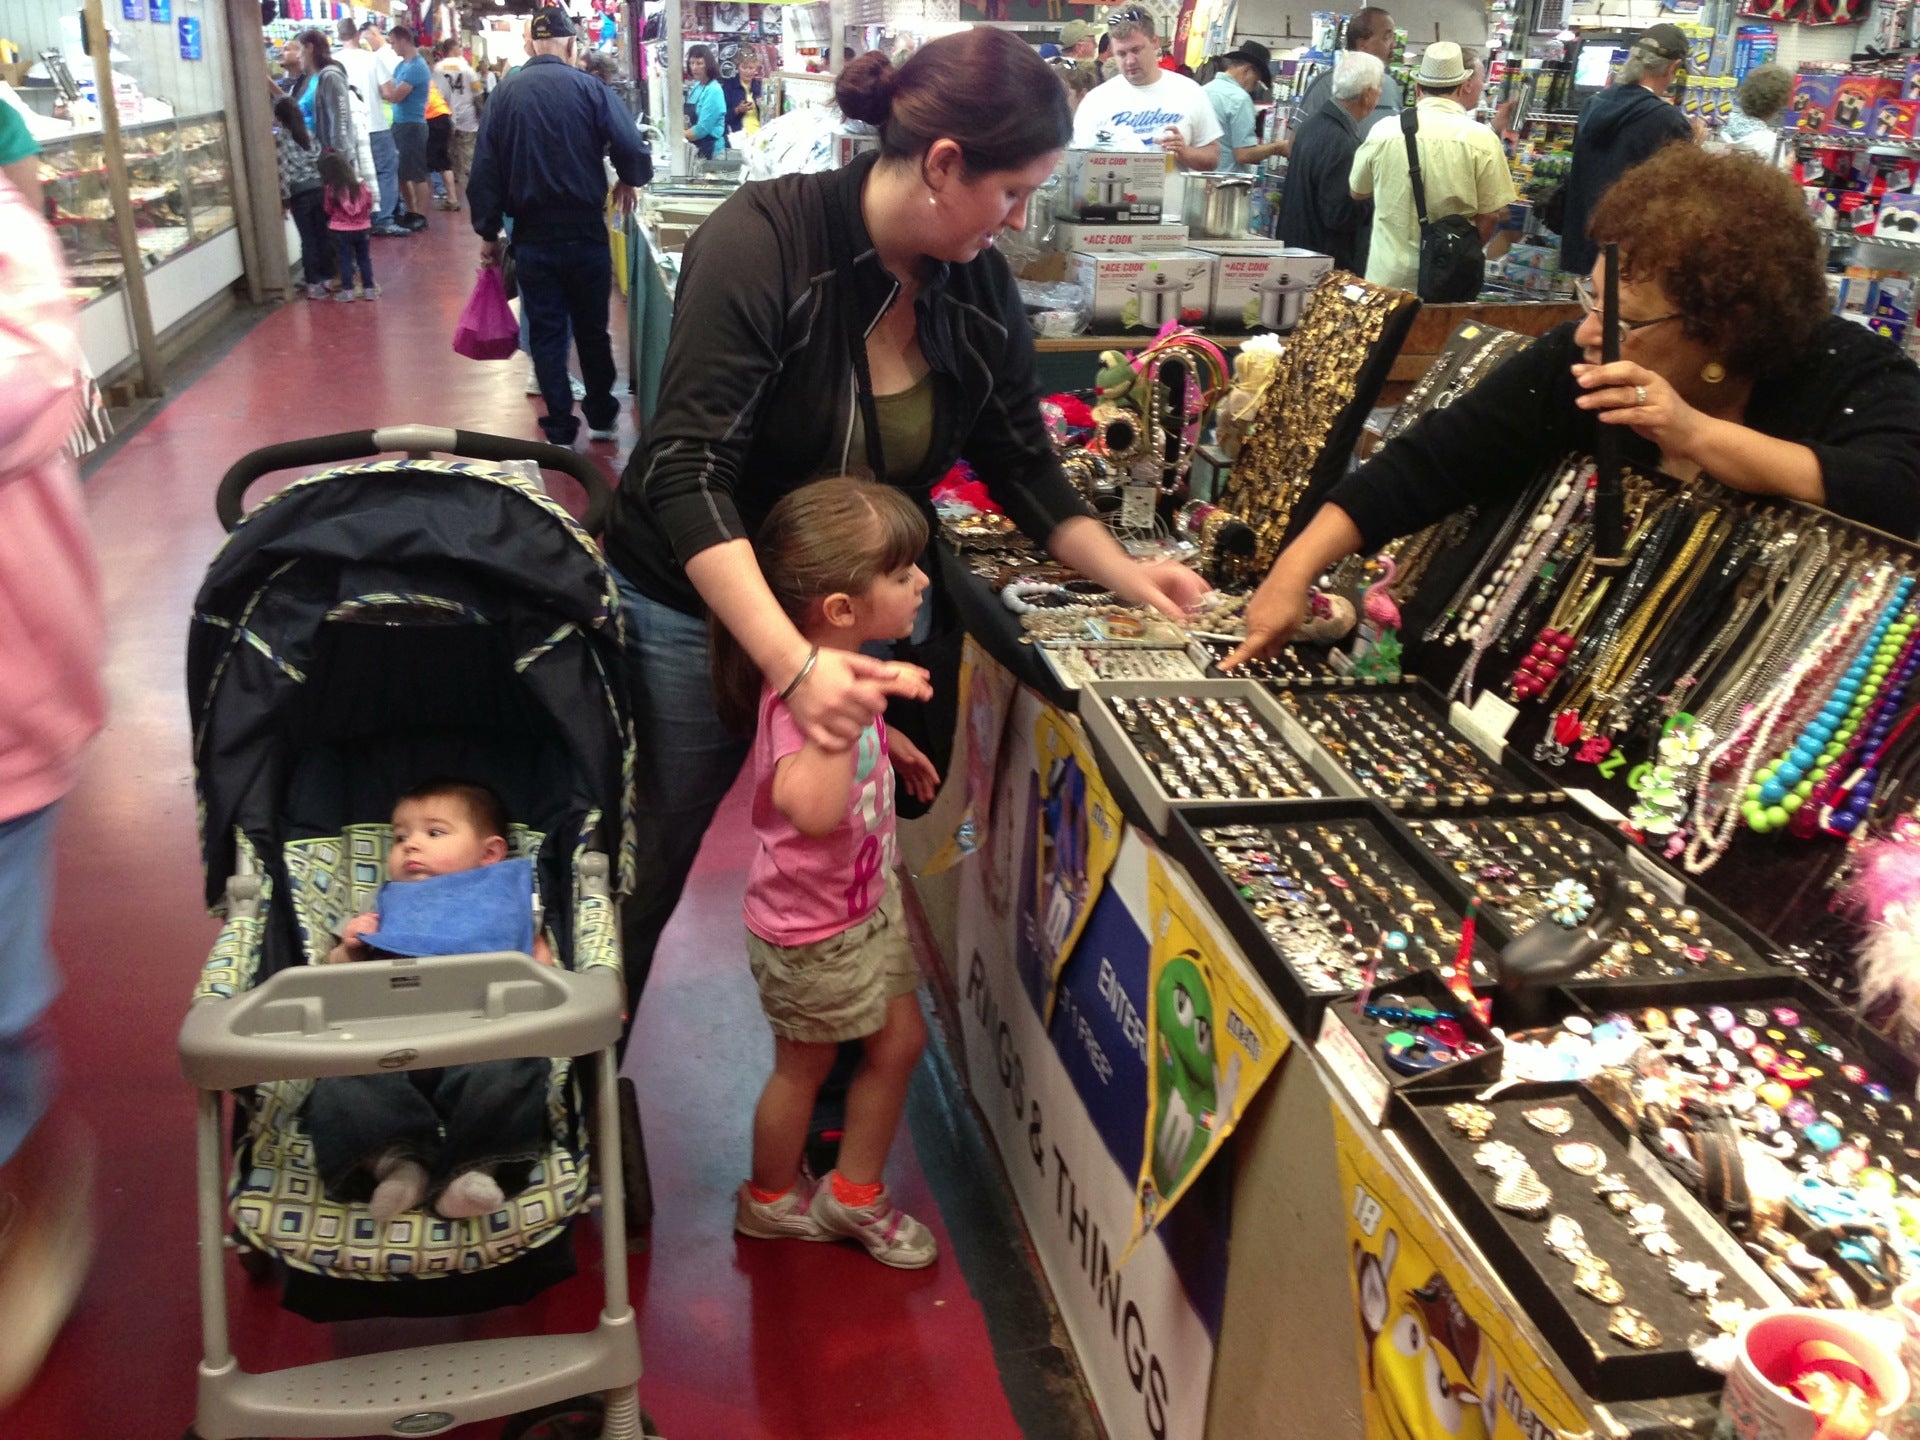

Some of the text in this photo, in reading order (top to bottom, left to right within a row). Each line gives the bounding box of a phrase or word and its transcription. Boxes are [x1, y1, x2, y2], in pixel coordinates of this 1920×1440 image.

[1087, 235, 1107, 244] ACE
[1108, 235, 1135, 244] COOK
[1105, 263, 1146, 271] ACE COOK
[1230, 262, 1271, 271] ACE COOK
[1053, 1144, 1168, 1440] THINGS
